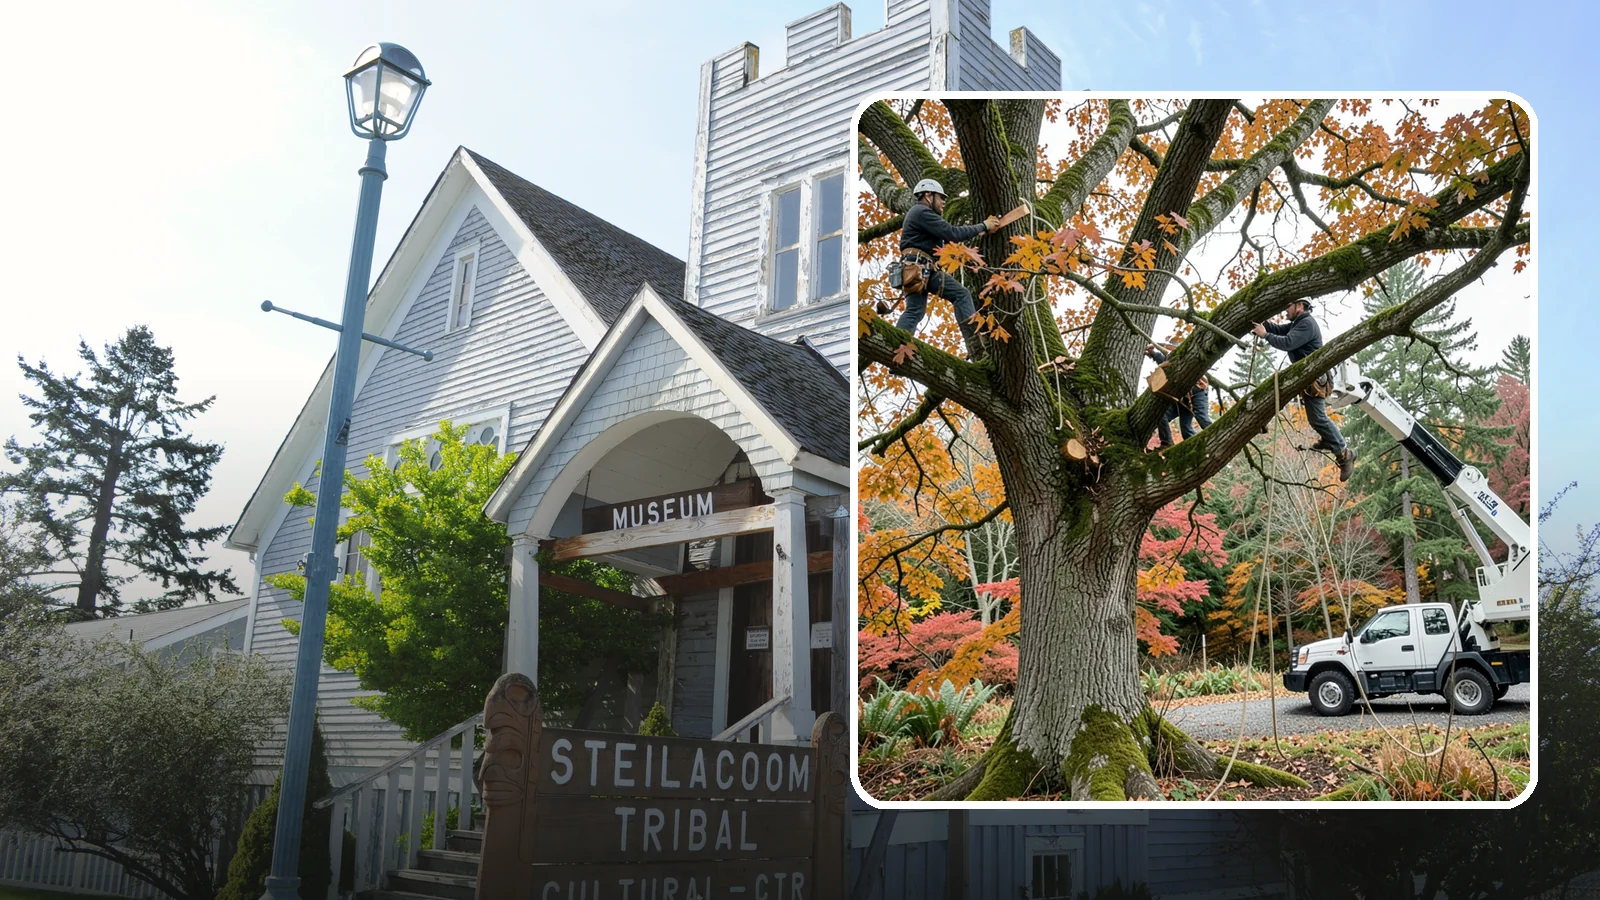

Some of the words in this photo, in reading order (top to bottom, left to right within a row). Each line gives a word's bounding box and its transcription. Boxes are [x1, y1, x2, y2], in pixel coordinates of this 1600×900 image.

[613, 491, 714, 530] MUSEUM
[551, 738, 809, 792] STEILACOOM
[615, 806, 757, 852] TRIBAL
